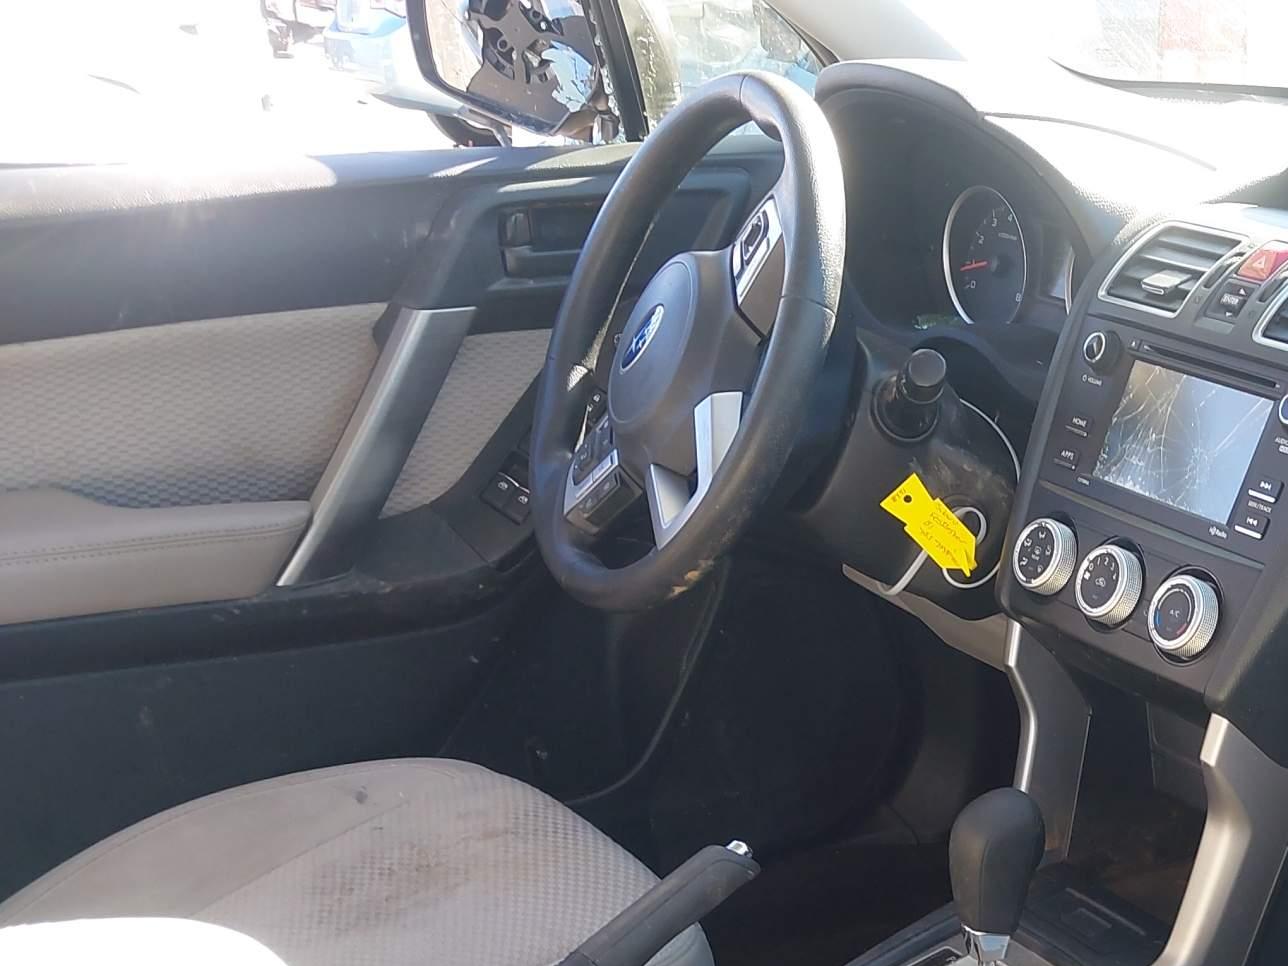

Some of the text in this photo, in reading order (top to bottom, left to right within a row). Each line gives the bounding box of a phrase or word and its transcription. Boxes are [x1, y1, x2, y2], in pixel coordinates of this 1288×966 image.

[991, 218, 998, 227] 3
[978, 235, 985, 244] 2
[970, 280, 977, 289] 0
[1072, 416, 1087, 428] HOME
[1061, 449, 1075, 461] APPS
[1089, 562, 1094, 571] 0
[1097, 556, 1101, 566] 1
[1104, 556, 1109, 566] 2
